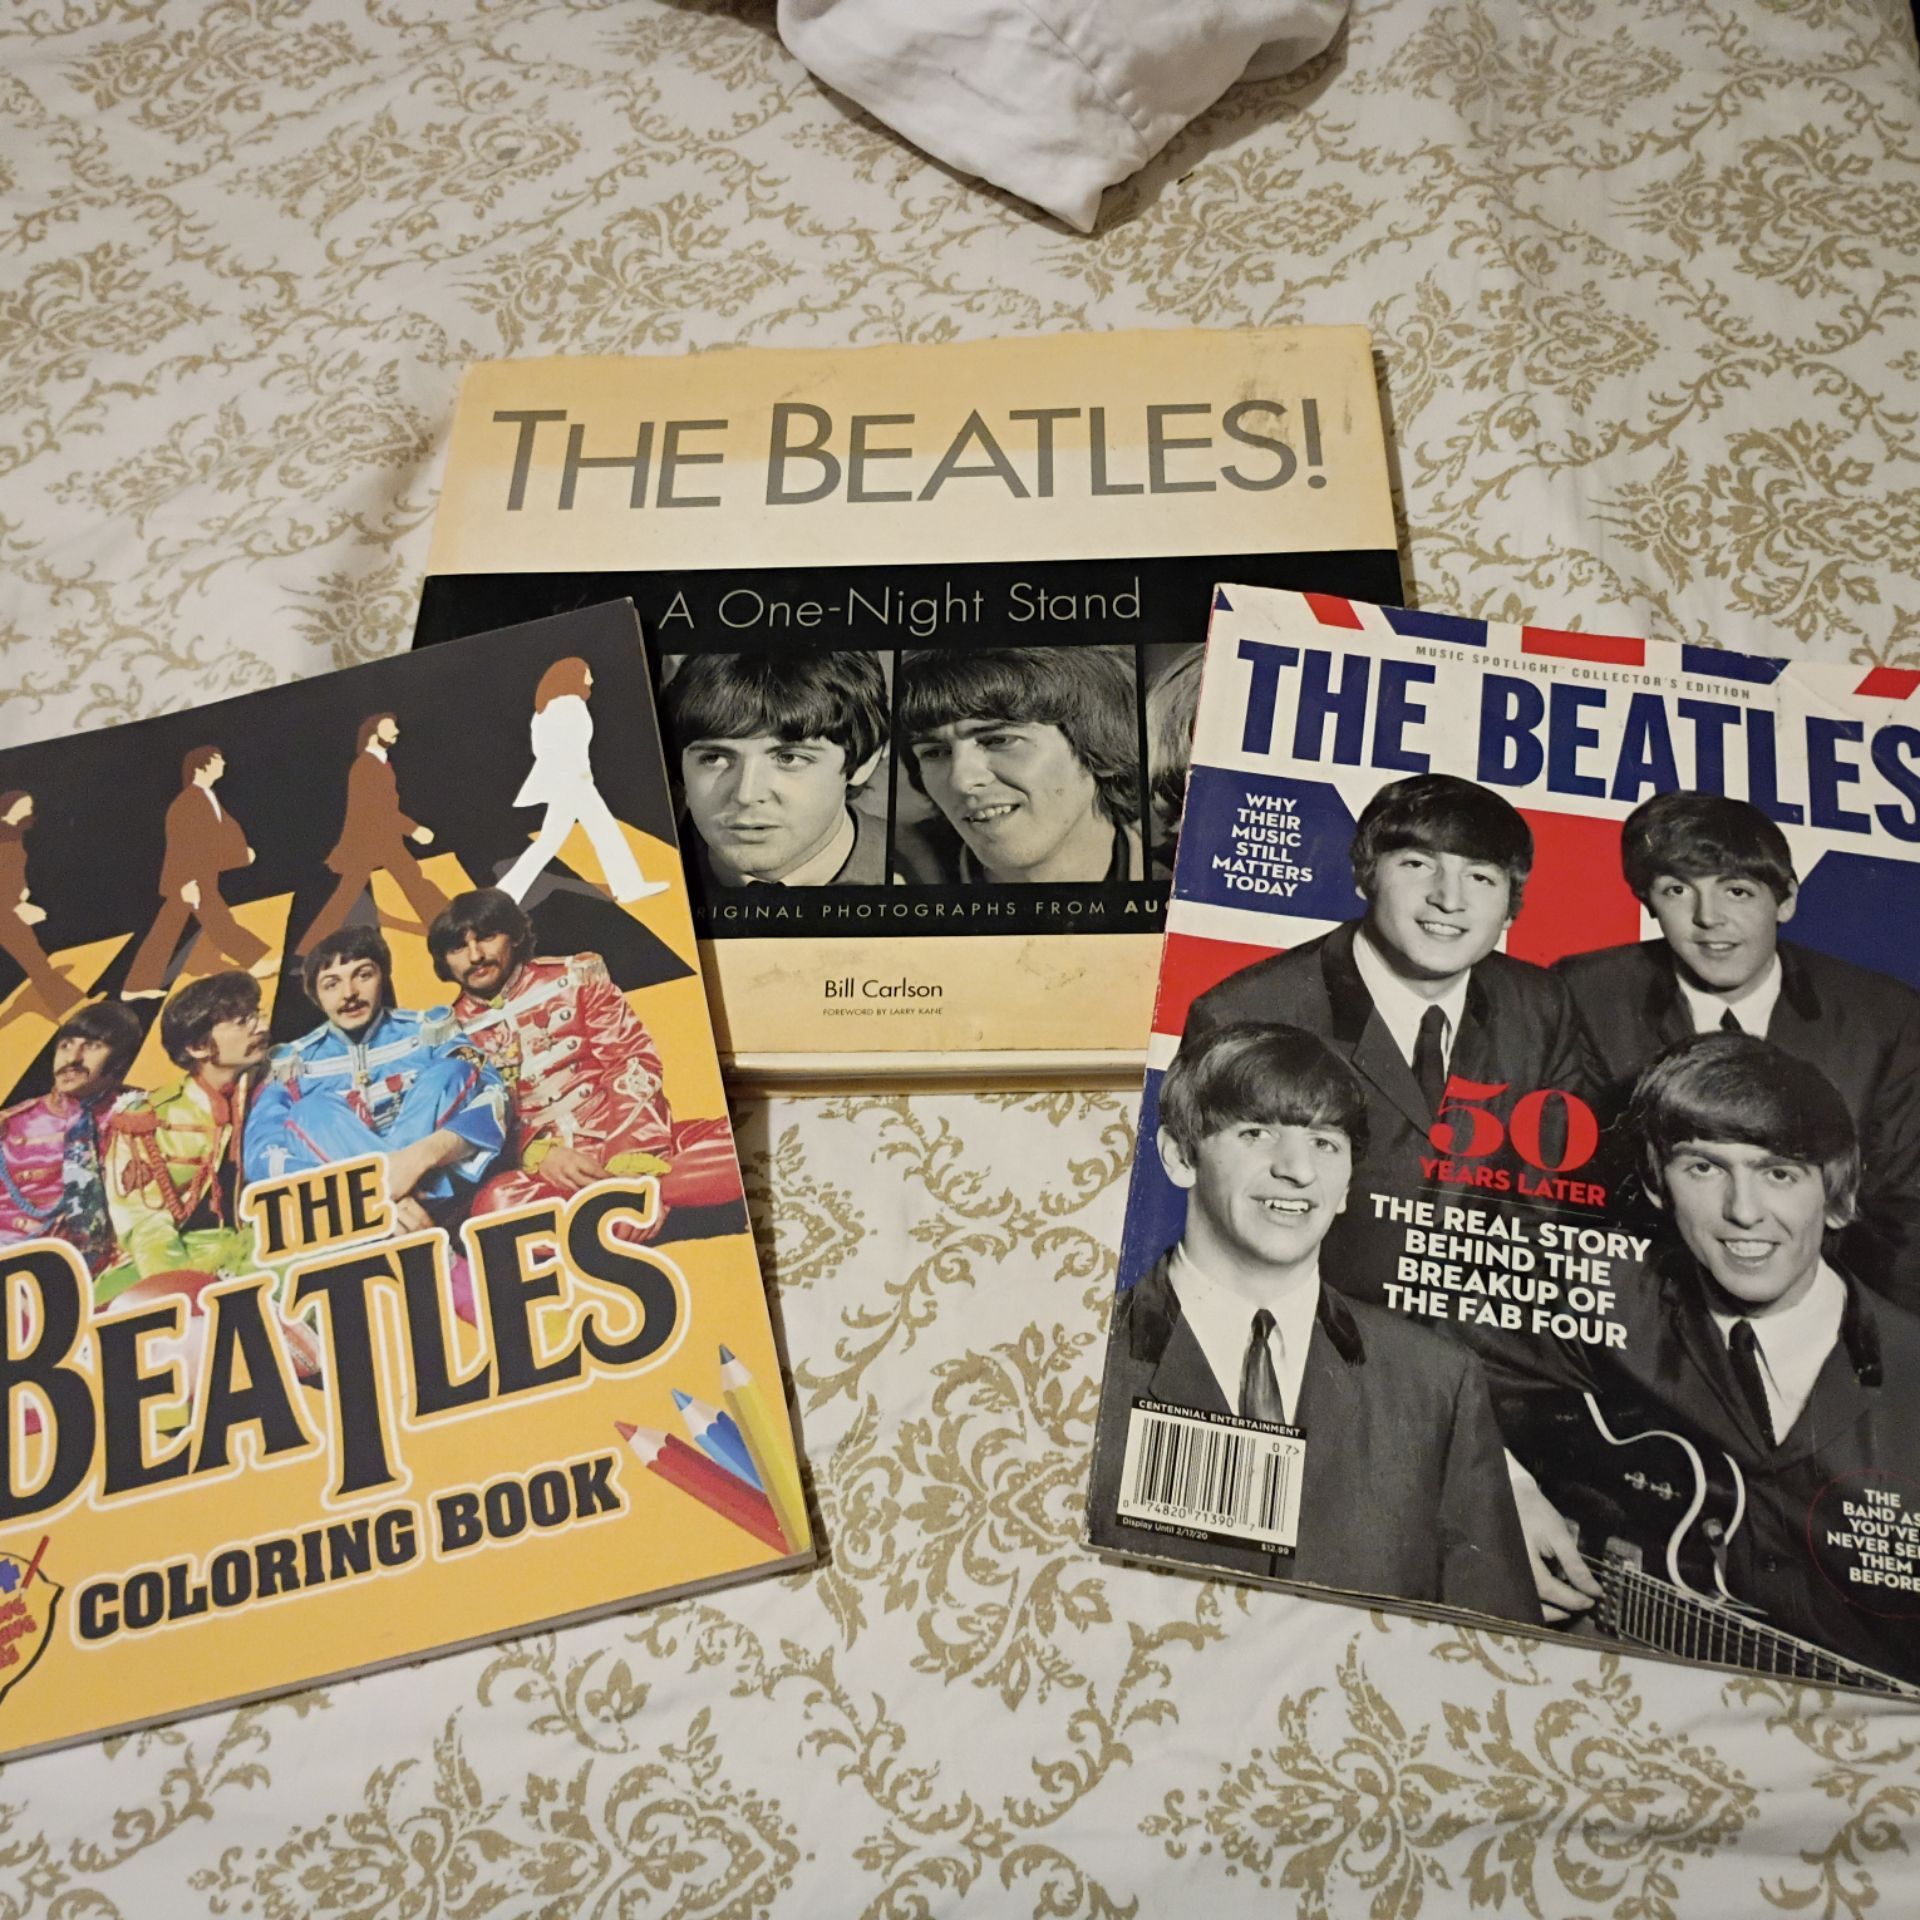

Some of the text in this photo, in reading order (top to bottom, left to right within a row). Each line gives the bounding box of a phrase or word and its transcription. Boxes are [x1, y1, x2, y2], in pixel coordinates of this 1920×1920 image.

[492, 399, 1328, 511] THE BEATLES!
[659, 576, 1140, 636] A One-Night Stand
[1416, 645, 1464, 661] MUSIC
[1572, 667, 1678, 688] COLLECTOR'S
[1686, 681, 1750, 699] EDITION
[1237, 639, 1920, 843] THE BEATLES
[1246, 793, 1297, 812] WHY
[1237, 808, 1301, 830] THEIR
[1231, 824, 1302, 847] MUSIC
[1235, 841, 1293, 863] STILL
[1212, 854, 1313, 882] MATTERS
[1223, 873, 1298, 897] TODAY
[696, 900, 1169, 919] RIGINAL PHOTOGRAPHS FROM AU
[825, 977, 943, 998] Bill Carlson
[823, 1007, 943, 1016] FOREWORD BY LARRY KANE
[1427, 1074, 1598, 1172] 50
[1419, 1155, 1606, 1206] YEARS LATER
[253, 1164, 387, 1254] THE
[1370, 1193, 1651, 1262] THE REAL STORY
[1405, 1228, 1611, 1286] BEHIND THE
[1397, 1256, 1616, 1316] BREAKUP OF
[1382, 1282, 1628, 1349] THE FAB FOUR
[0, 1188, 678, 1520] BEATLES
[1138, 1400, 1300, 1437] CENTENNIAL ENTERTAINMENT
[1864, 1488, 1902, 1508] THE
[1122, 1517, 1152, 1531] Display
[1155, 1523, 1174, 1534] Until
[1147, 1502, 1186, 1518] 74820
[1195, 1511, 1234, 1528] 71390
[1249, 1523, 1255, 1531] 7
[1842, 1501, 1920, 1527] BAND AS
[1827, 1530, 1920, 1560] NEVER SE
[1849, 1518, 1919, 1543] YOU'VE
[78, 1456, 622, 1642] COLORING BOOK
[1858, 1551, 1913, 1574] THEM
[1850, 1567, 1920, 1593] BEFORE
